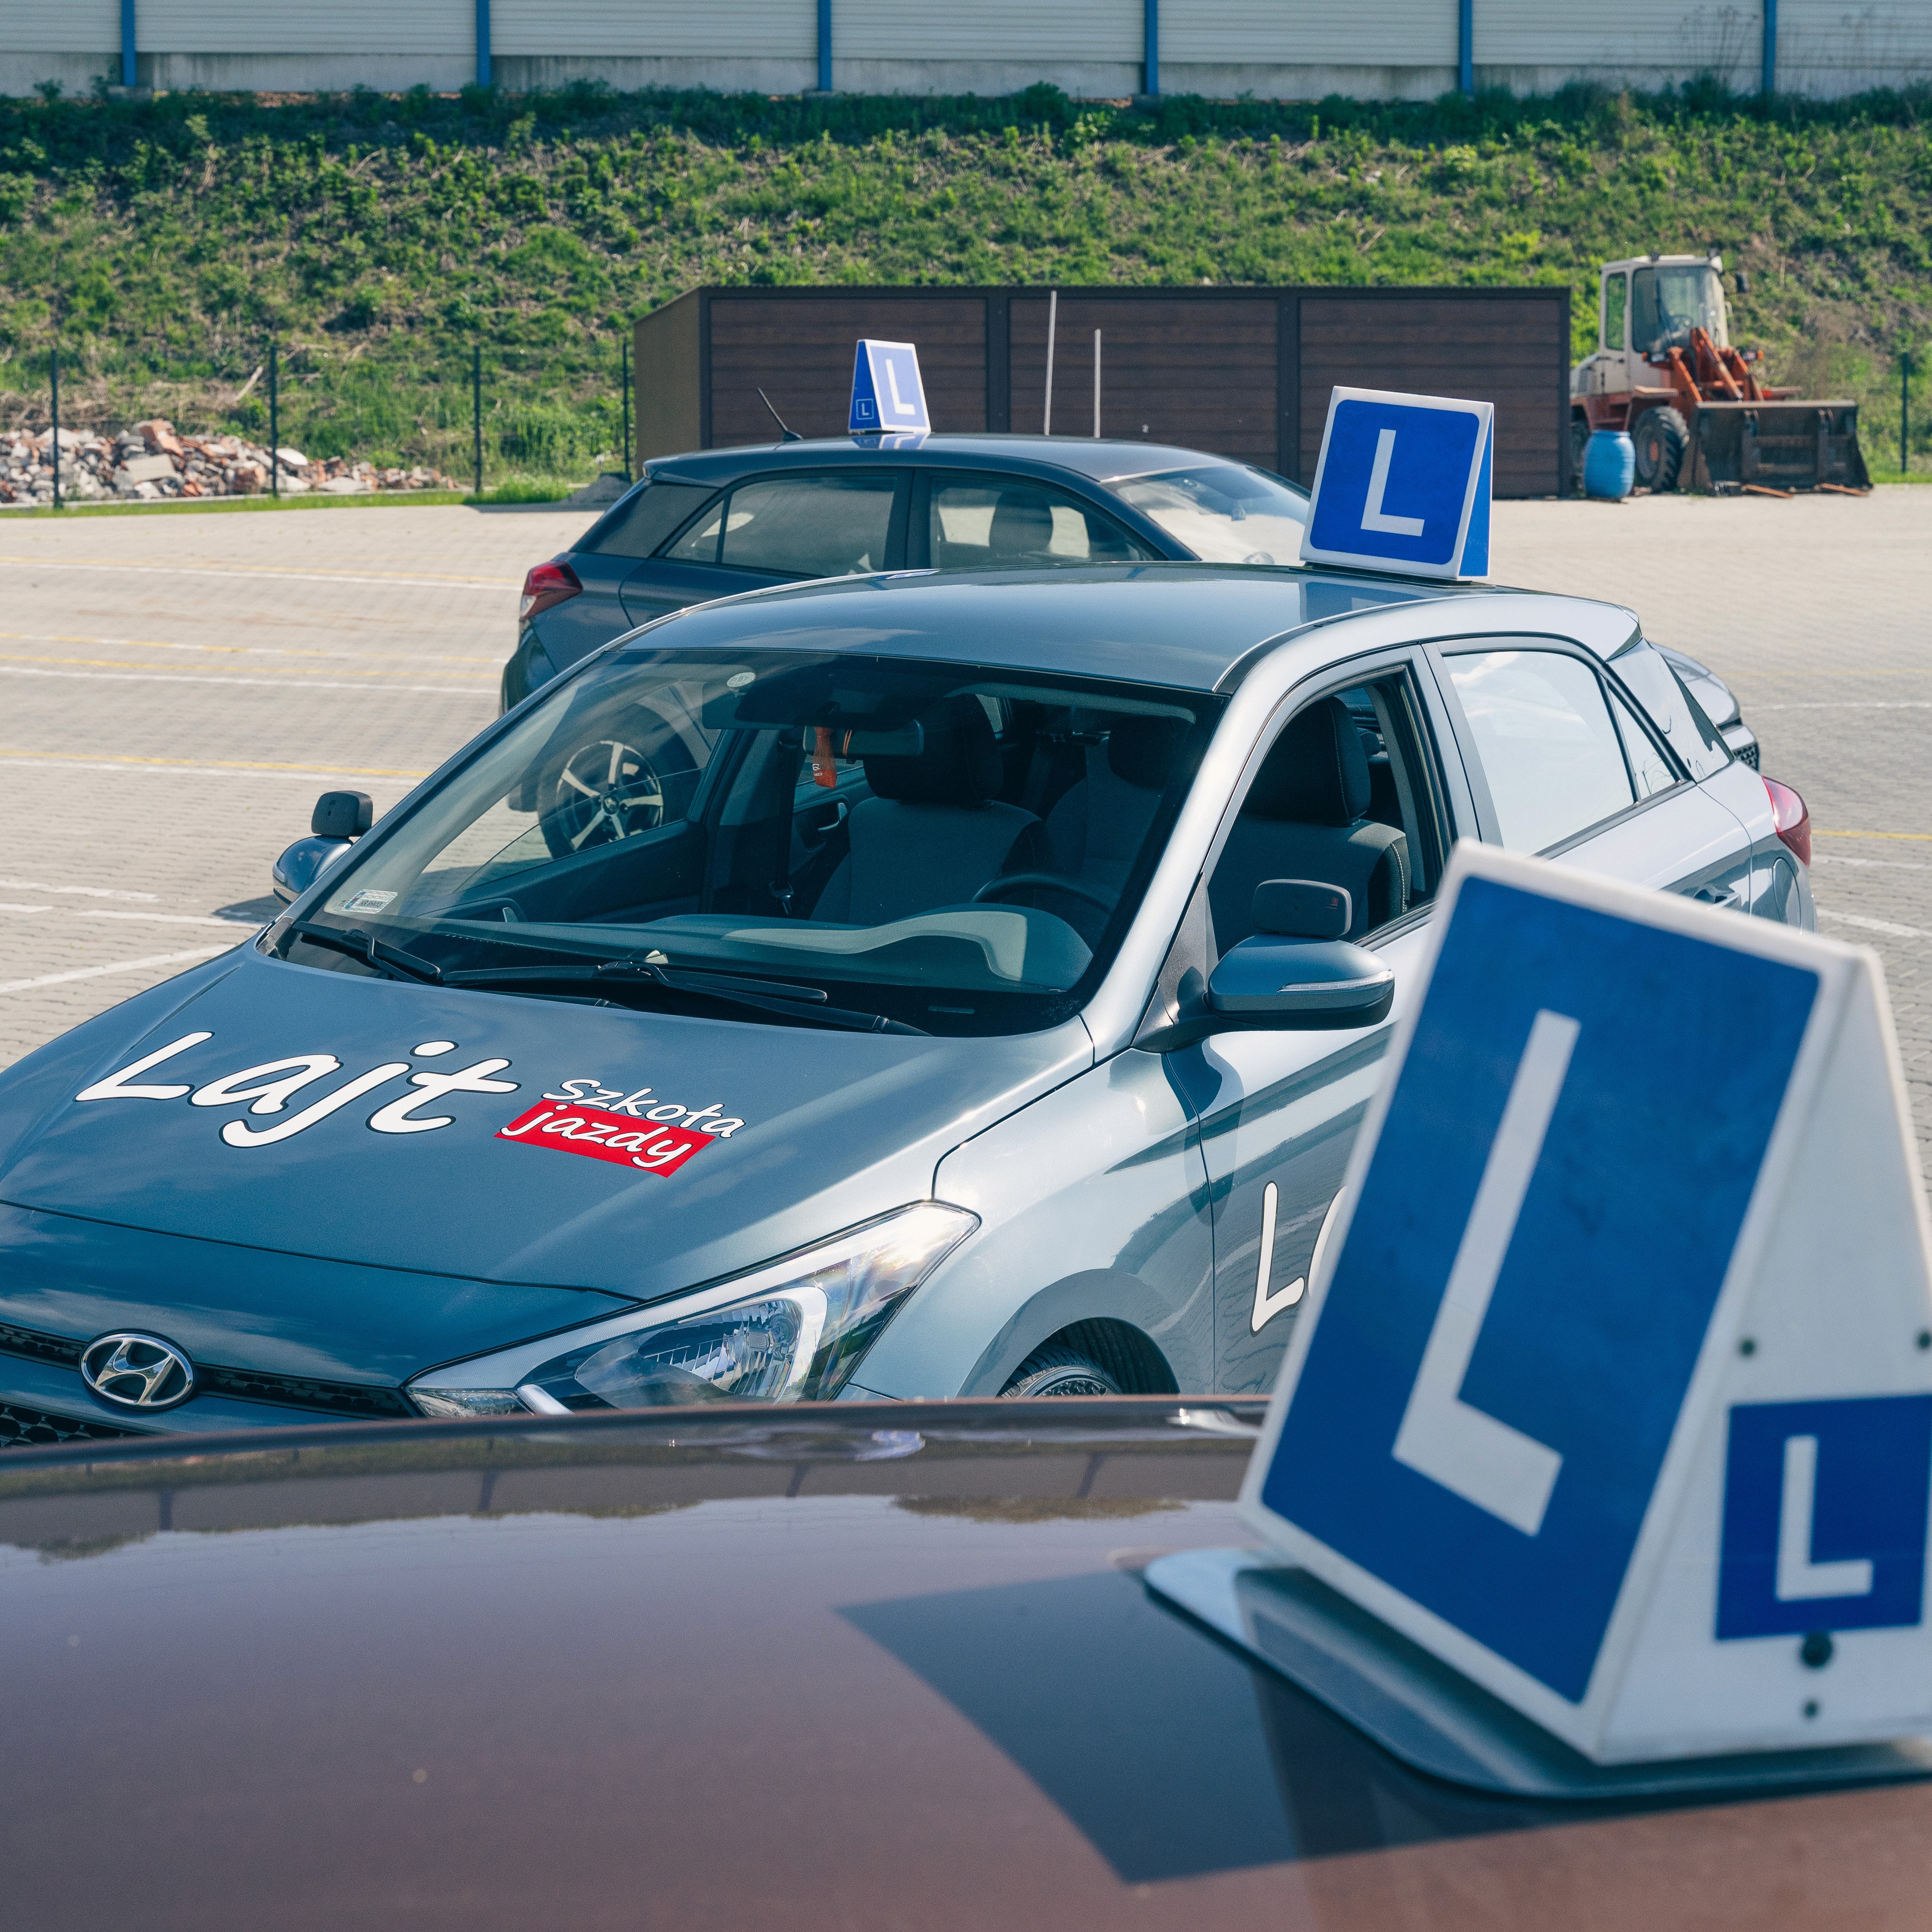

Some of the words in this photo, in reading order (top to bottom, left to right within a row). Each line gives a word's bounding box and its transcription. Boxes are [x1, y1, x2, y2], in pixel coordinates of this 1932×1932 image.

[861, 403, 869, 415] L
[886, 359, 915, 415] L
[1360, 428, 1425, 537] L
[74, 1031, 521, 1148] Lajt
[541, 1079, 746, 1138] Szkoła
[499, 1104, 693, 1168] jazdy
[1391, 1008, 1581, 1537] L
[1774, 1434, 1875, 1603] L
